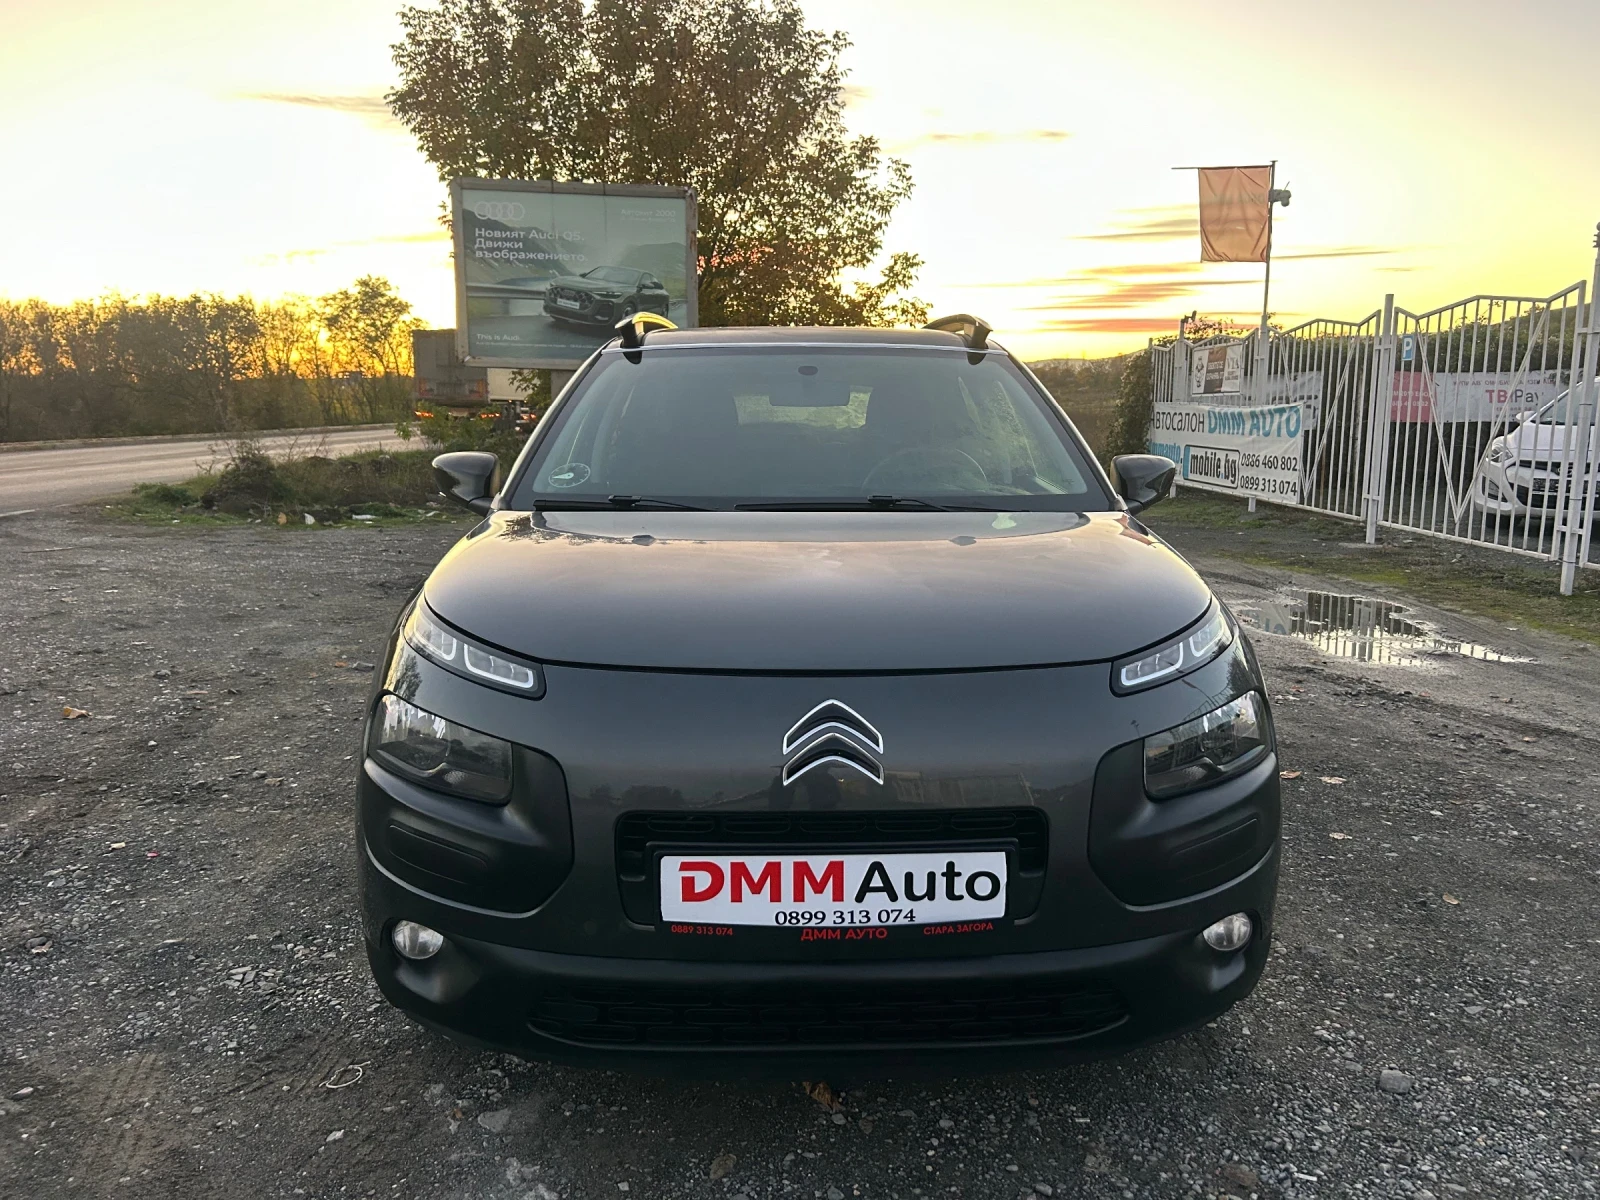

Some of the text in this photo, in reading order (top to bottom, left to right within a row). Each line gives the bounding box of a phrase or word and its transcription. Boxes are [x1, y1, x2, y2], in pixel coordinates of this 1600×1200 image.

[475, 227, 585, 242] Новият Audi Q5.
[474, 238, 523, 249] Движи
[475, 249, 588, 263] въображението.
[476, 333, 492, 341] This
[1403, 337, 1413, 359] P
[1149, 406, 1301, 439] Автосалон DMM AUTO
[1189, 450, 1237, 484] mobile.bg
[1240, 453, 1298, 472] 0886 460 802
[1239, 475, 1298, 496] 0899 313 074
[678, 860, 1002, 904] DMM Auto
[775, 908, 916, 926] 0899 313 074
[671, 925, 734, 936] 0889 313 074
[800, 928, 888, 941] ДММ АУТО
[923, 922, 993, 936] СТАРА ЗАГОРА
